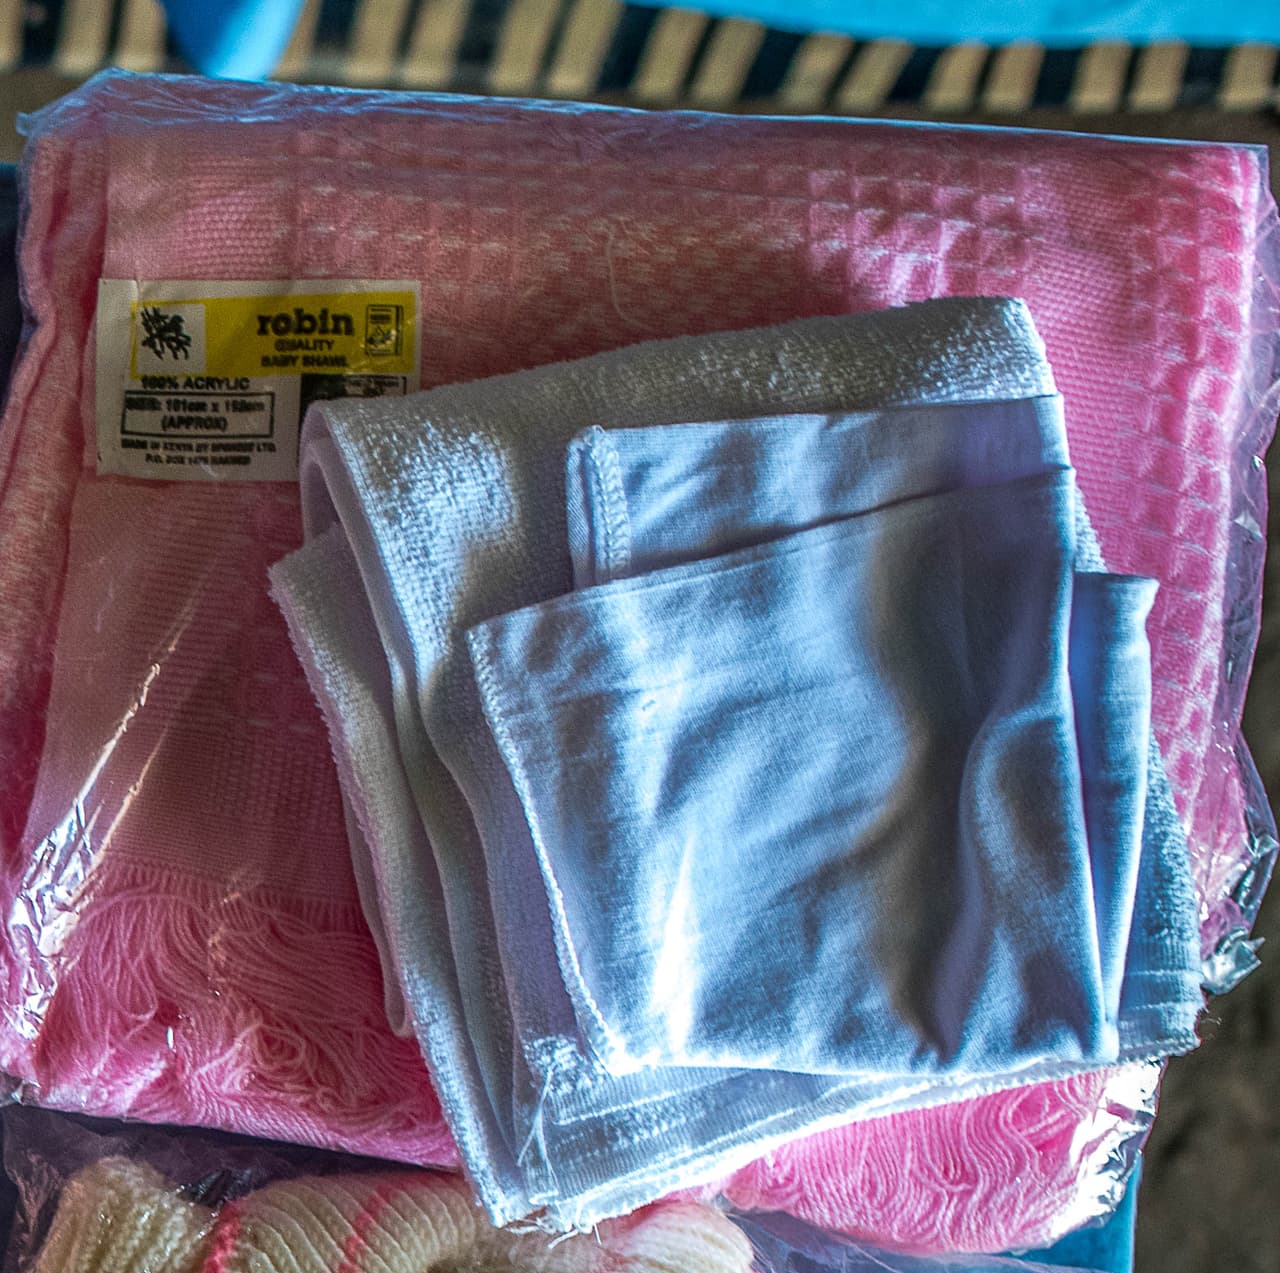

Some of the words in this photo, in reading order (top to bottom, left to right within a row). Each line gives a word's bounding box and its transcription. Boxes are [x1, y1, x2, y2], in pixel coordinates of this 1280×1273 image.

[256, 308, 354, 336] robin
[274, 338, 335, 352] QUALITY
[261, 355, 299, 367] BABY
[183, 377, 250, 391] ACRYLIC
[161, 416, 228, 431] (APPROX)
